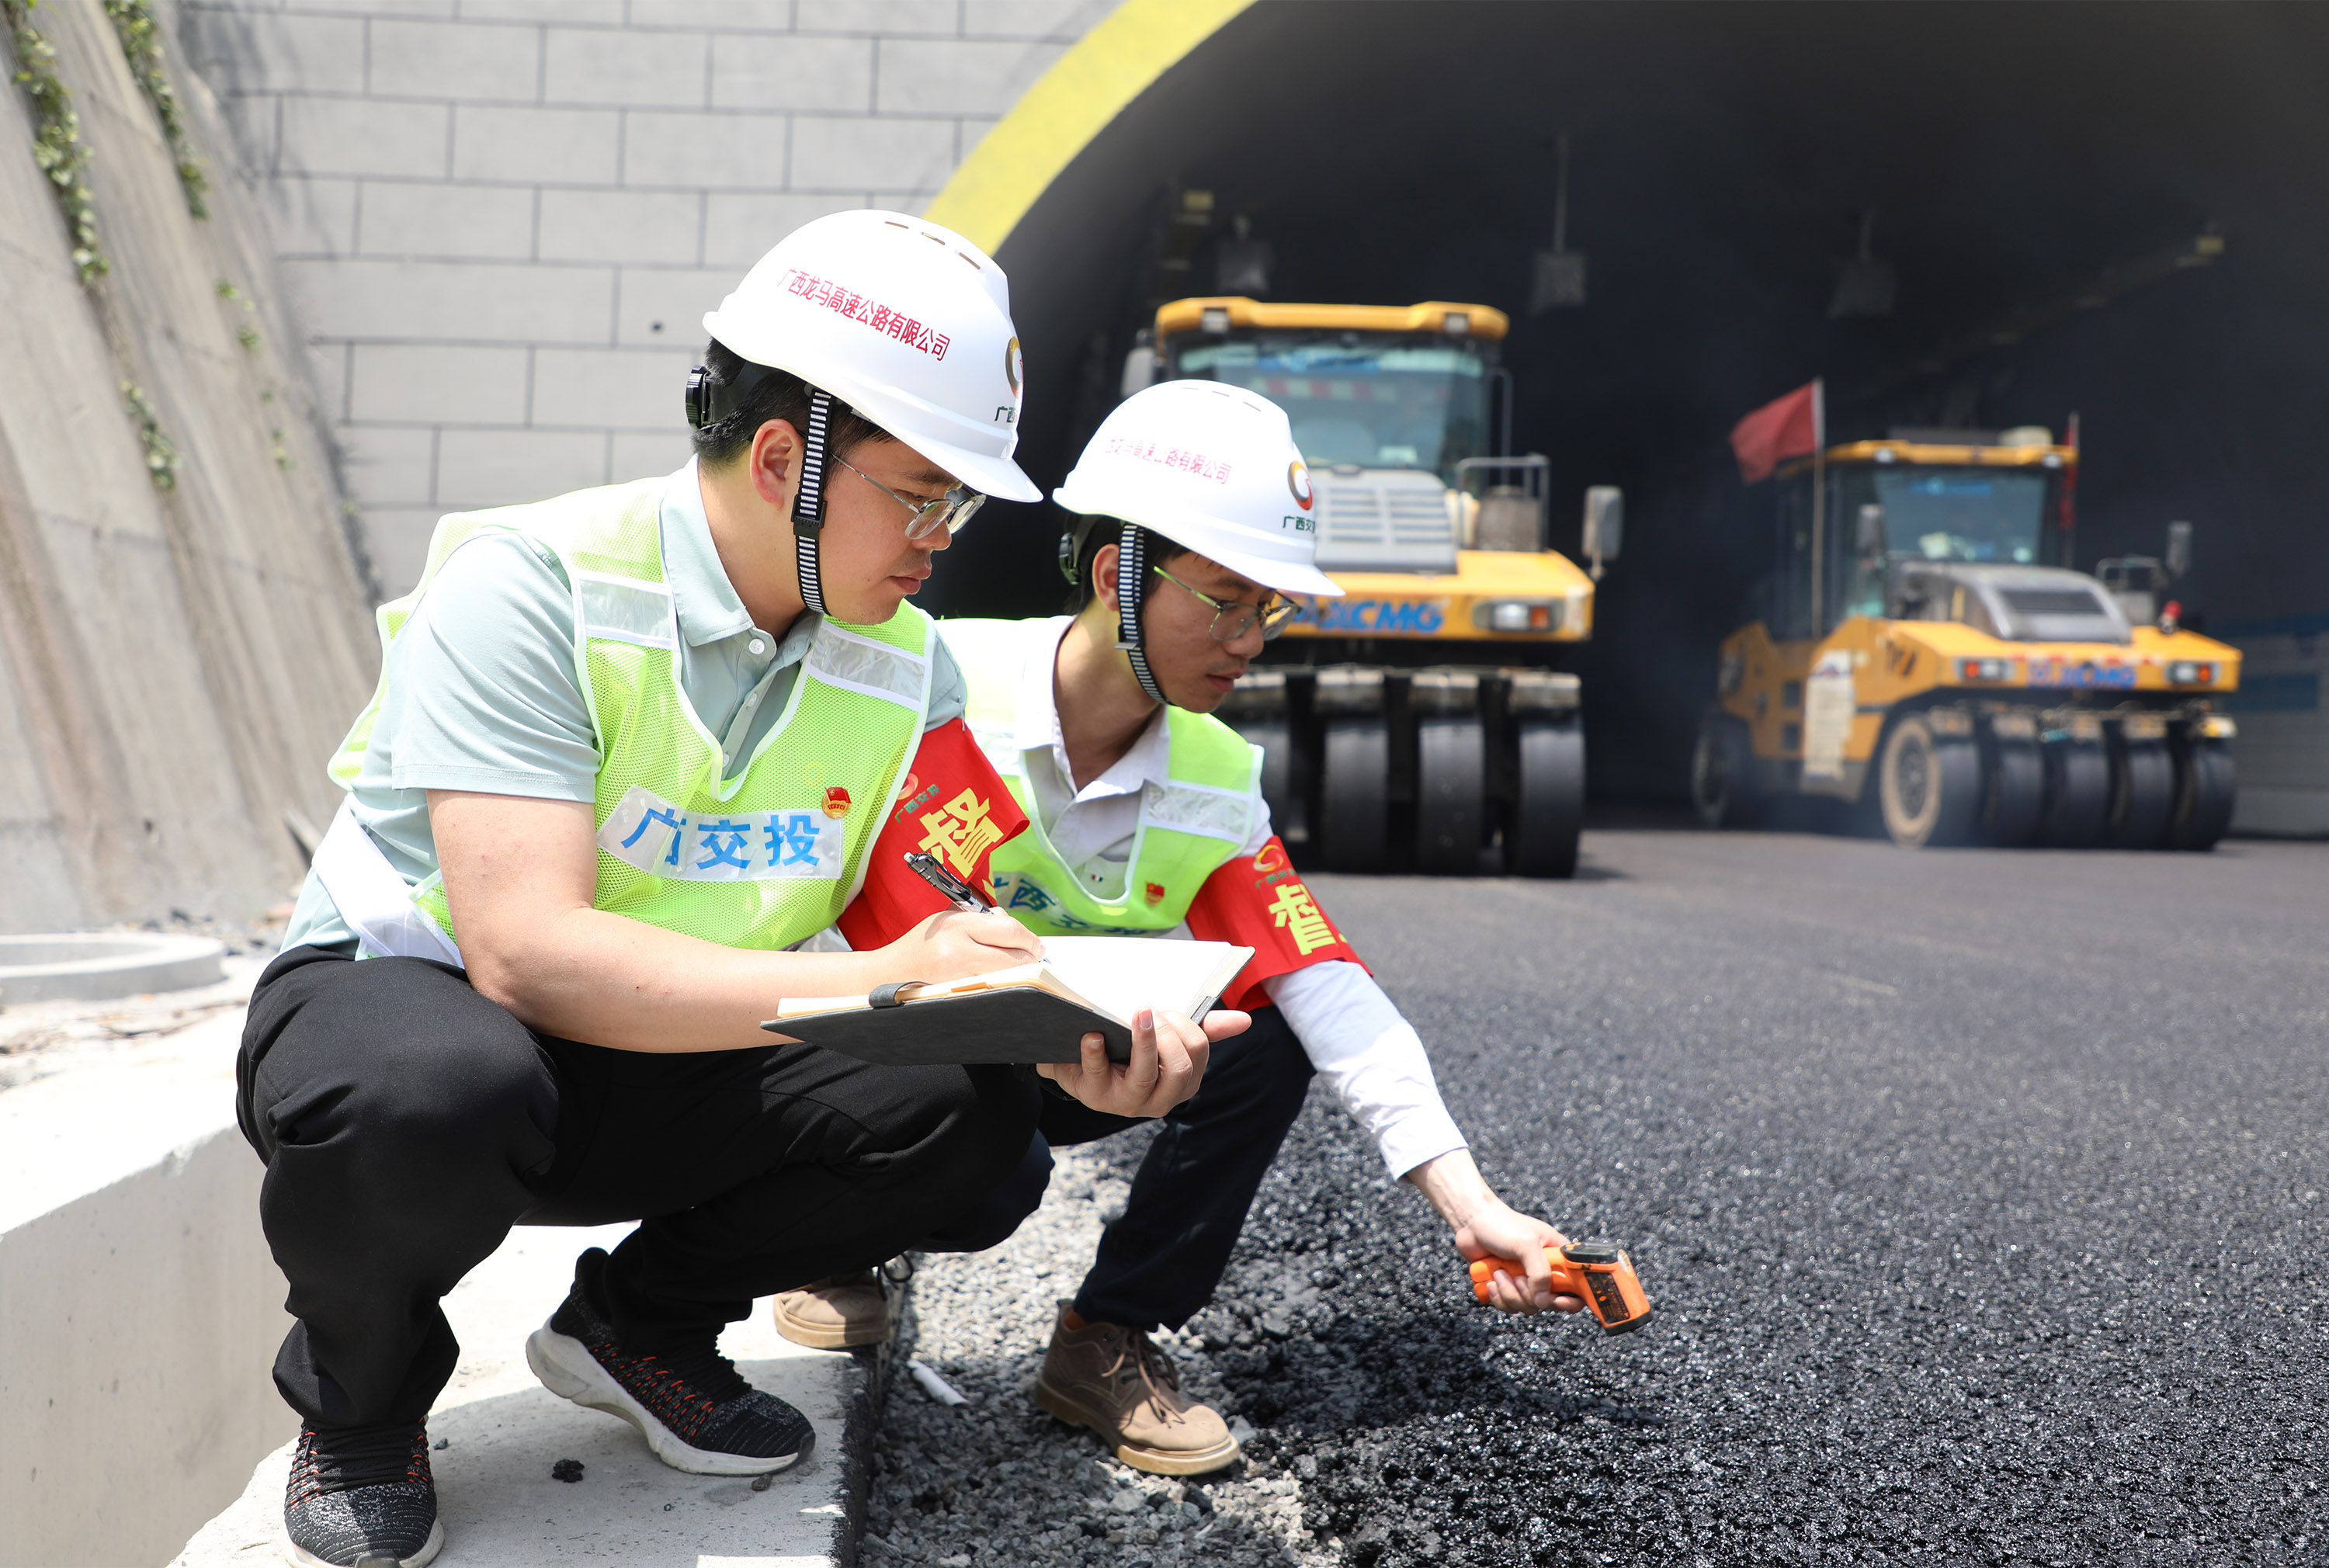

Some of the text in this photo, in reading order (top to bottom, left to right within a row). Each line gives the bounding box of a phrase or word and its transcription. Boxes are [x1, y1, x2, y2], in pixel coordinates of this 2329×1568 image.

[777, 268, 950, 361] 广西龙马高速公路有限公司
[1283, 515, 1315, 533] 广西交
[894, 783, 941, 824] 广西交投
[918, 787, 1004, 902] 督
[1268, 883, 1348, 956] 督
